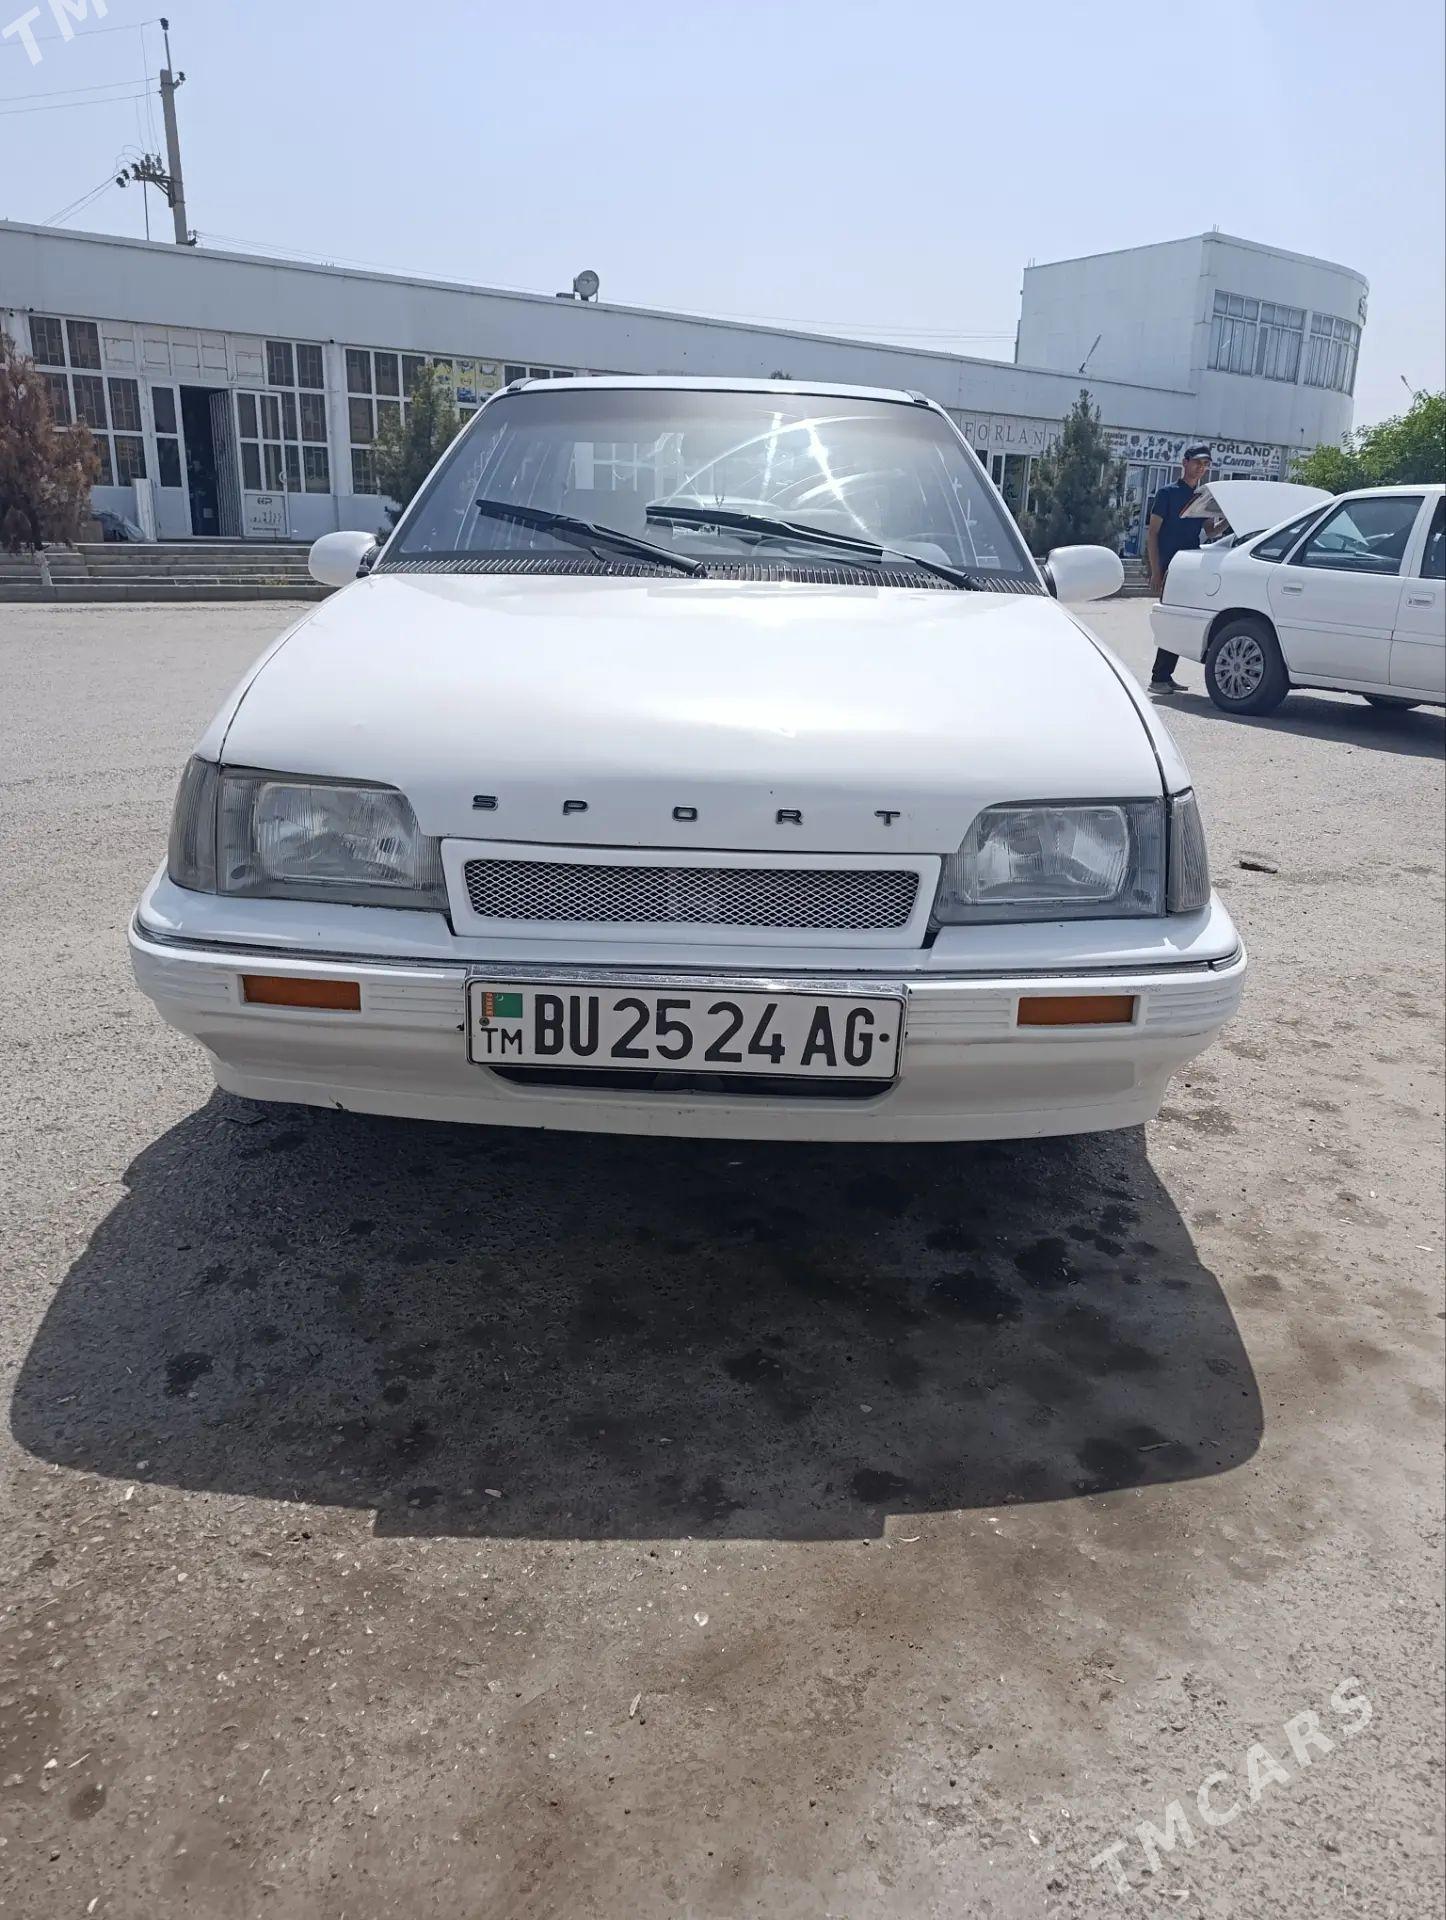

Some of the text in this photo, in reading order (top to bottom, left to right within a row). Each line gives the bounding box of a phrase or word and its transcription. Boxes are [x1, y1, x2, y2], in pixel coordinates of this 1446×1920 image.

[964, 421, 1062, 447] FORLAND
[1209, 442, 1271, 457] FORLAND
[472, 794, 901, 827] SPORT
[480, 1027, 523, 1055] TM
